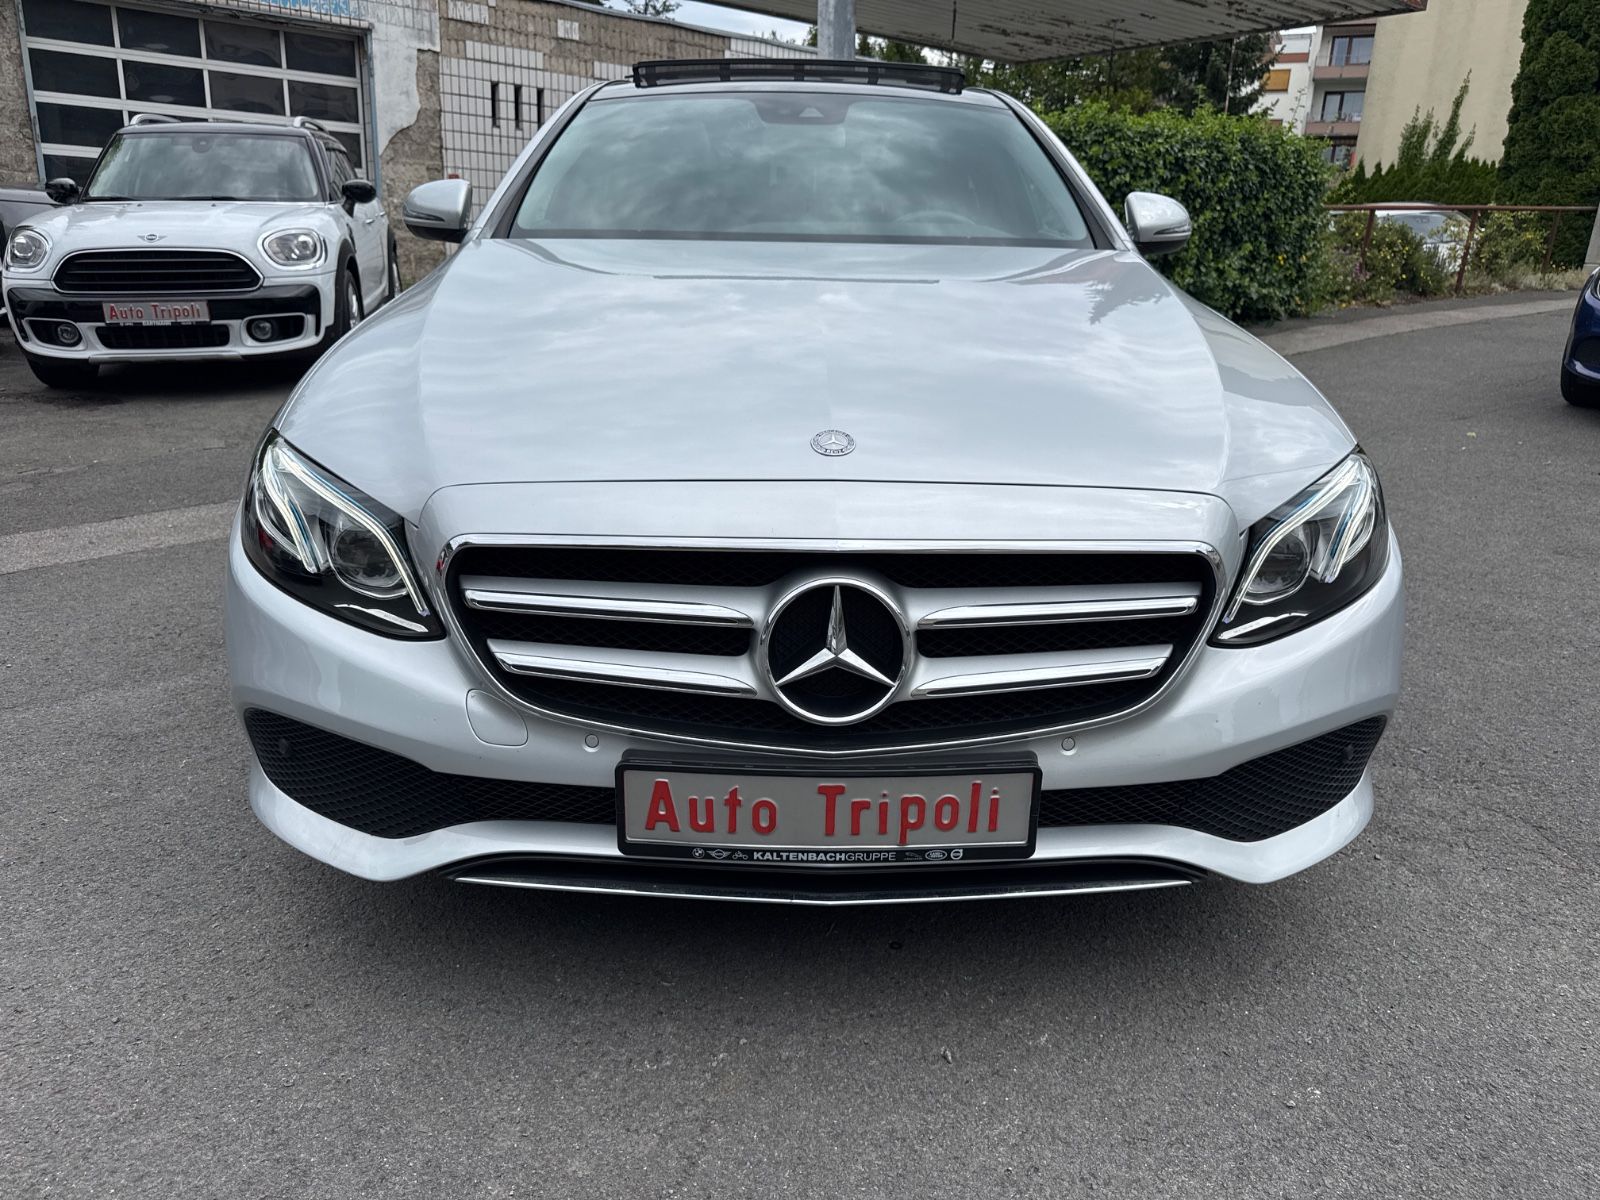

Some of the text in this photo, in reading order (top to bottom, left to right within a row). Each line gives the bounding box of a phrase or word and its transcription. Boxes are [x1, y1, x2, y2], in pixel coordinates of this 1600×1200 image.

[110, 302, 200, 322] Auto Tripoli
[644, 779, 1000, 846] Auto Tripoli
[753, 851, 896, 861] KALTENBACHGRUPPE
